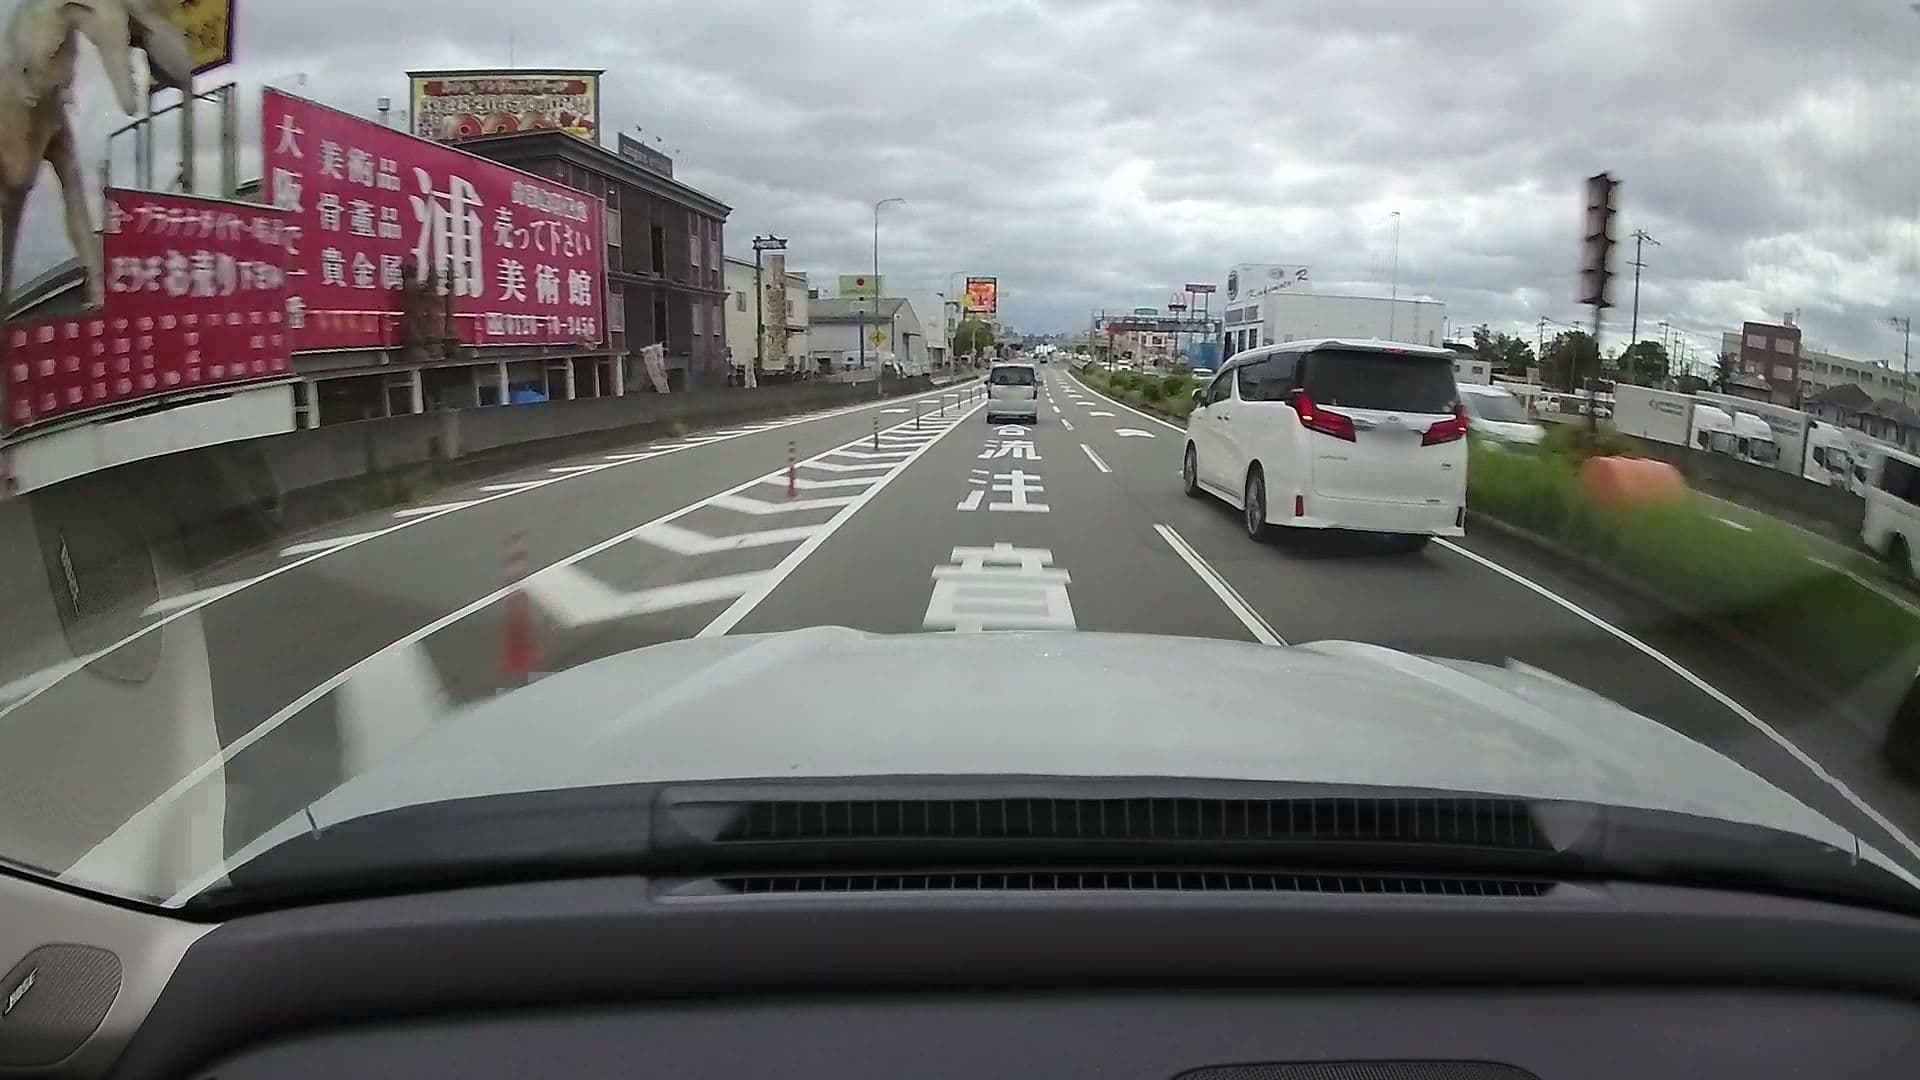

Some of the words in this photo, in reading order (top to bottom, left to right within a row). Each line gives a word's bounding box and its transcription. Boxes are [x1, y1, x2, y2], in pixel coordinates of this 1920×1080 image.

[319, 139, 401, 192] 美術品
[315, 192, 402, 240] 骨董品
[408, 166, 485, 298] 浦
[493, 206, 592, 258] 売って下さい
[321, 247, 404, 291] 貴金属
[496, 257, 592, 307] 美術館
